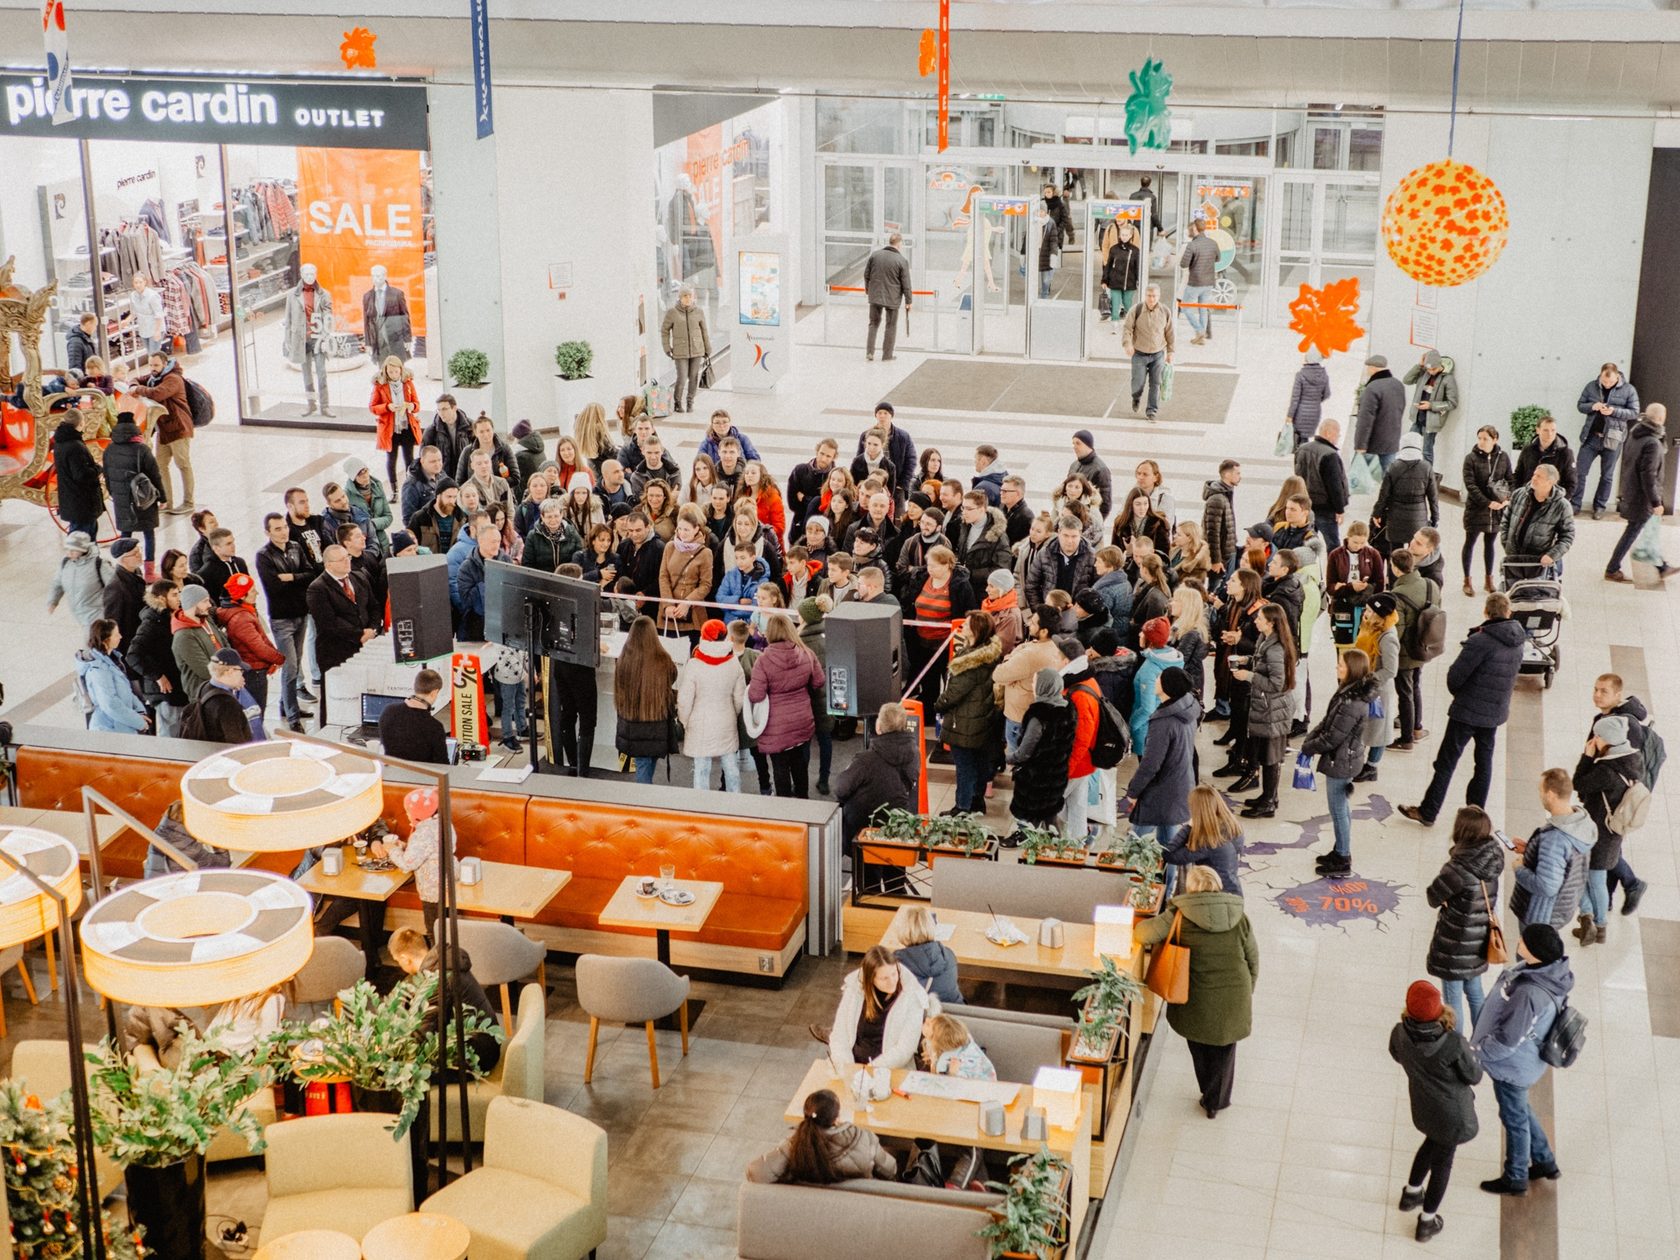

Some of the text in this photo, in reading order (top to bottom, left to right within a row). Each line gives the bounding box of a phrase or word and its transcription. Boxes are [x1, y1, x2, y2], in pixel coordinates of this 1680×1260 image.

[141, 83, 278, 124] cardin
[294, 108, 385, 128] OUTLET
[308, 200, 413, 237] SALE
[461, 693, 474, 745] UTION SALE
[1318, 896, 1379, 914] 70%
